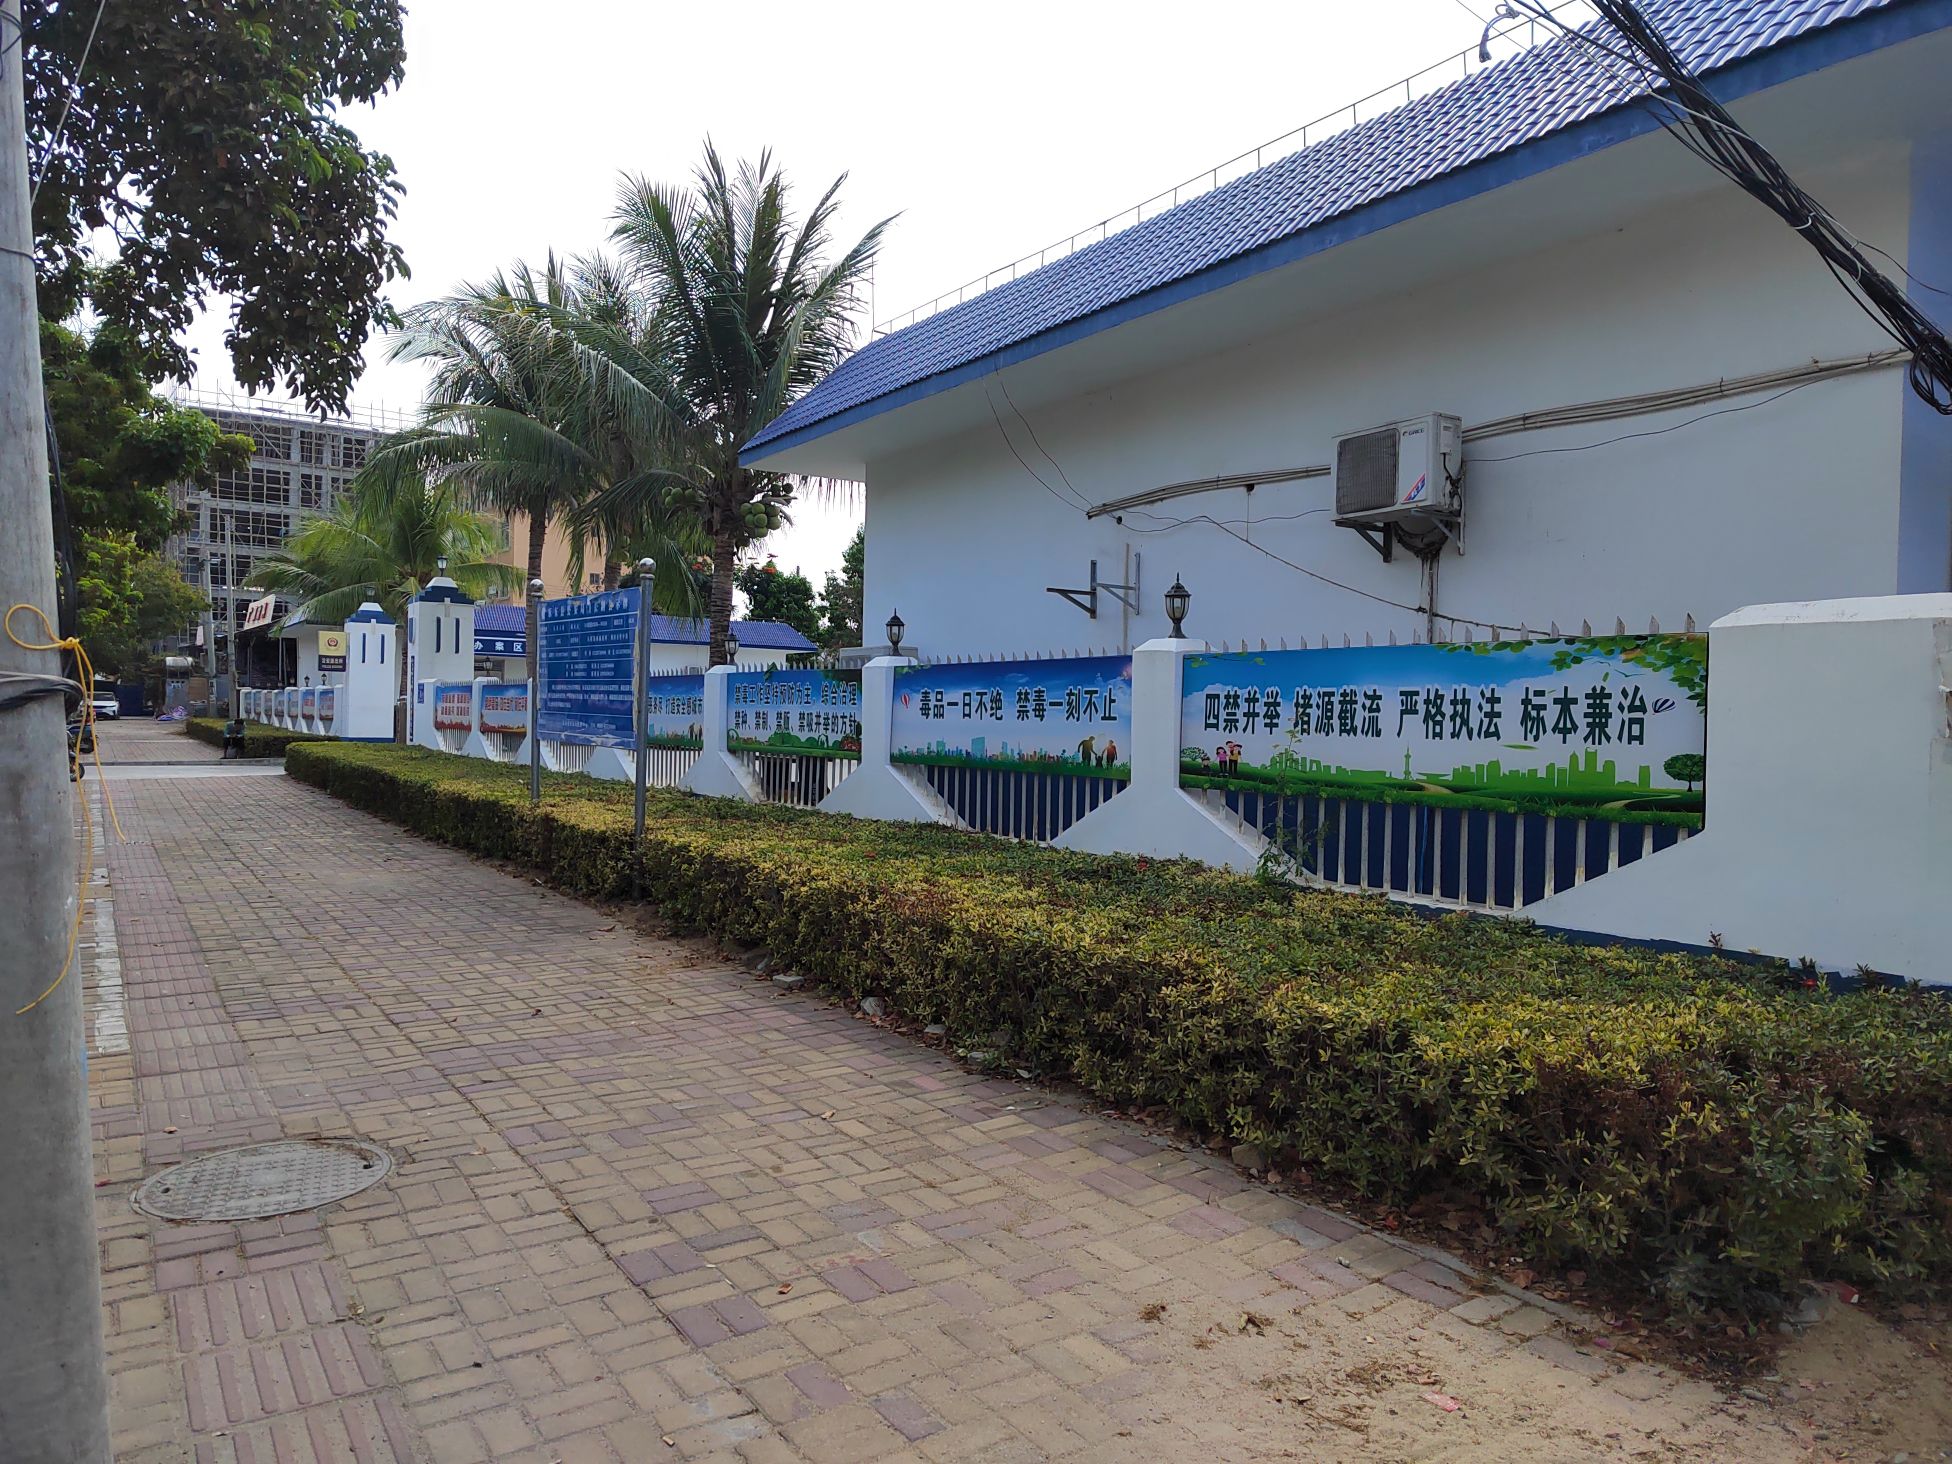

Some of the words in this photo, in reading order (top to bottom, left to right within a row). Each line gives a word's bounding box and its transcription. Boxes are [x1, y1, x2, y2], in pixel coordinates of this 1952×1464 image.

[474, 641, 523, 652] 办案区
[919, 688, 1004, 721] 毒品一日不绝
[1016, 686, 1118, 723] 禁毒一刻不止
[1203, 688, 1281, 735] 四禁并举
[1293, 687, 1383, 738] 堵源截流
[1396, 686, 1502, 742] 严格执法
[1520, 685, 1648, 746] 标本兼治
